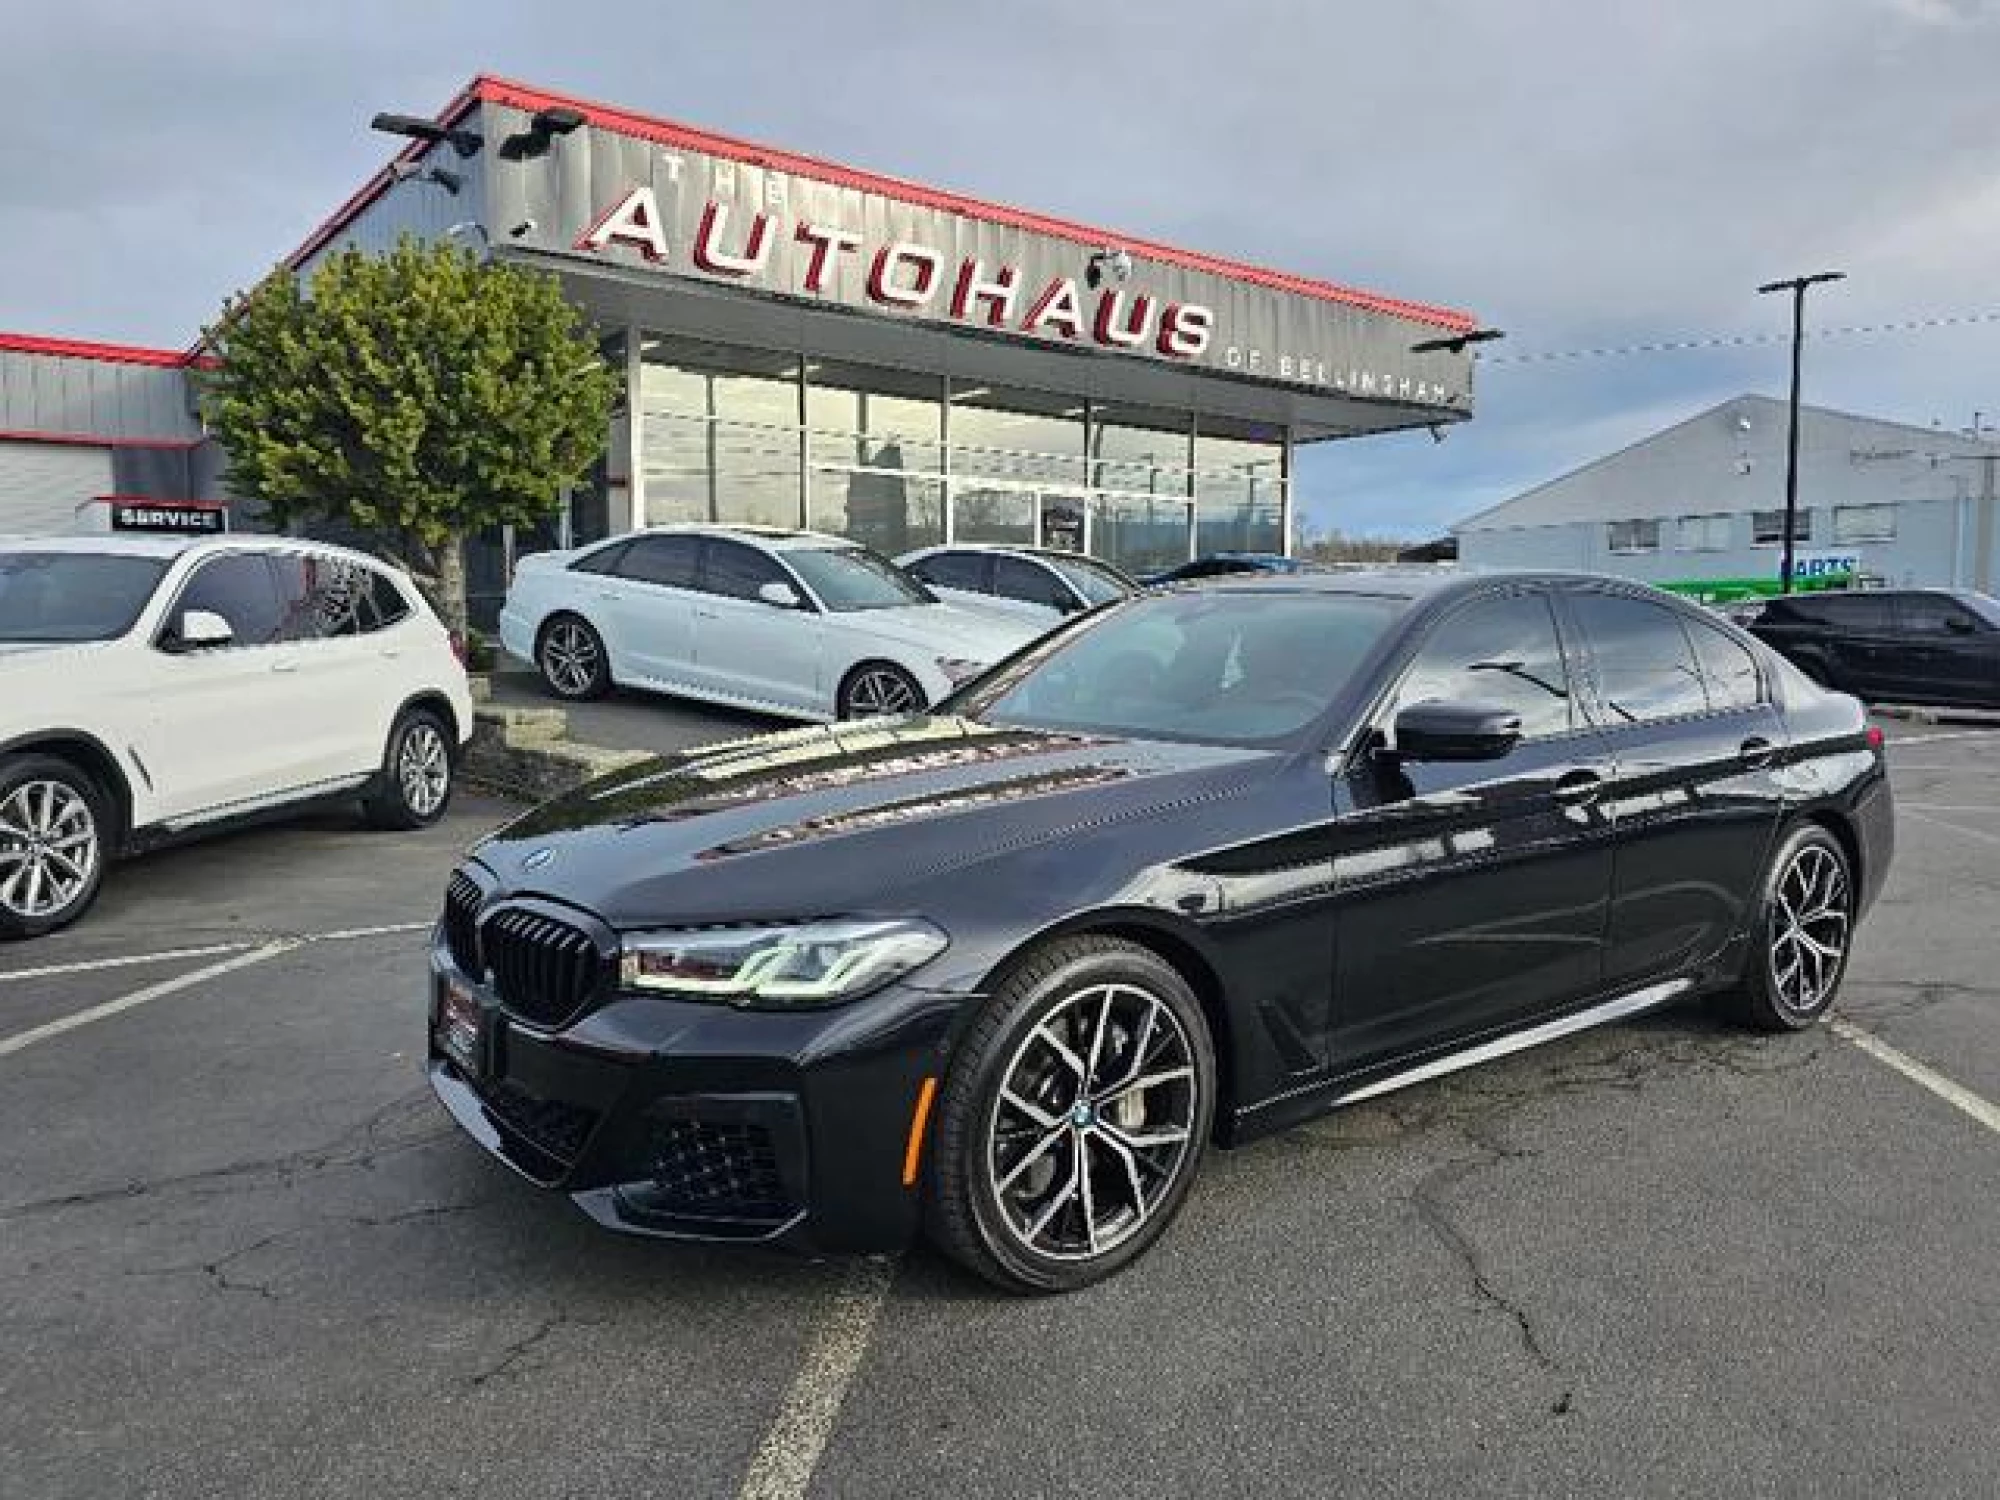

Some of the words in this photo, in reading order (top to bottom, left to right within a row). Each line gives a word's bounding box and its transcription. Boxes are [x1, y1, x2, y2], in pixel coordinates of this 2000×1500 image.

[662, 154, 783, 204] THE
[575, 185, 1214, 358] AUTOHAUS
[1226, 346, 1260, 371] OF
[1280, 355, 1446, 396] BELLINGHAM
[121, 508, 216, 526] SERVICE
